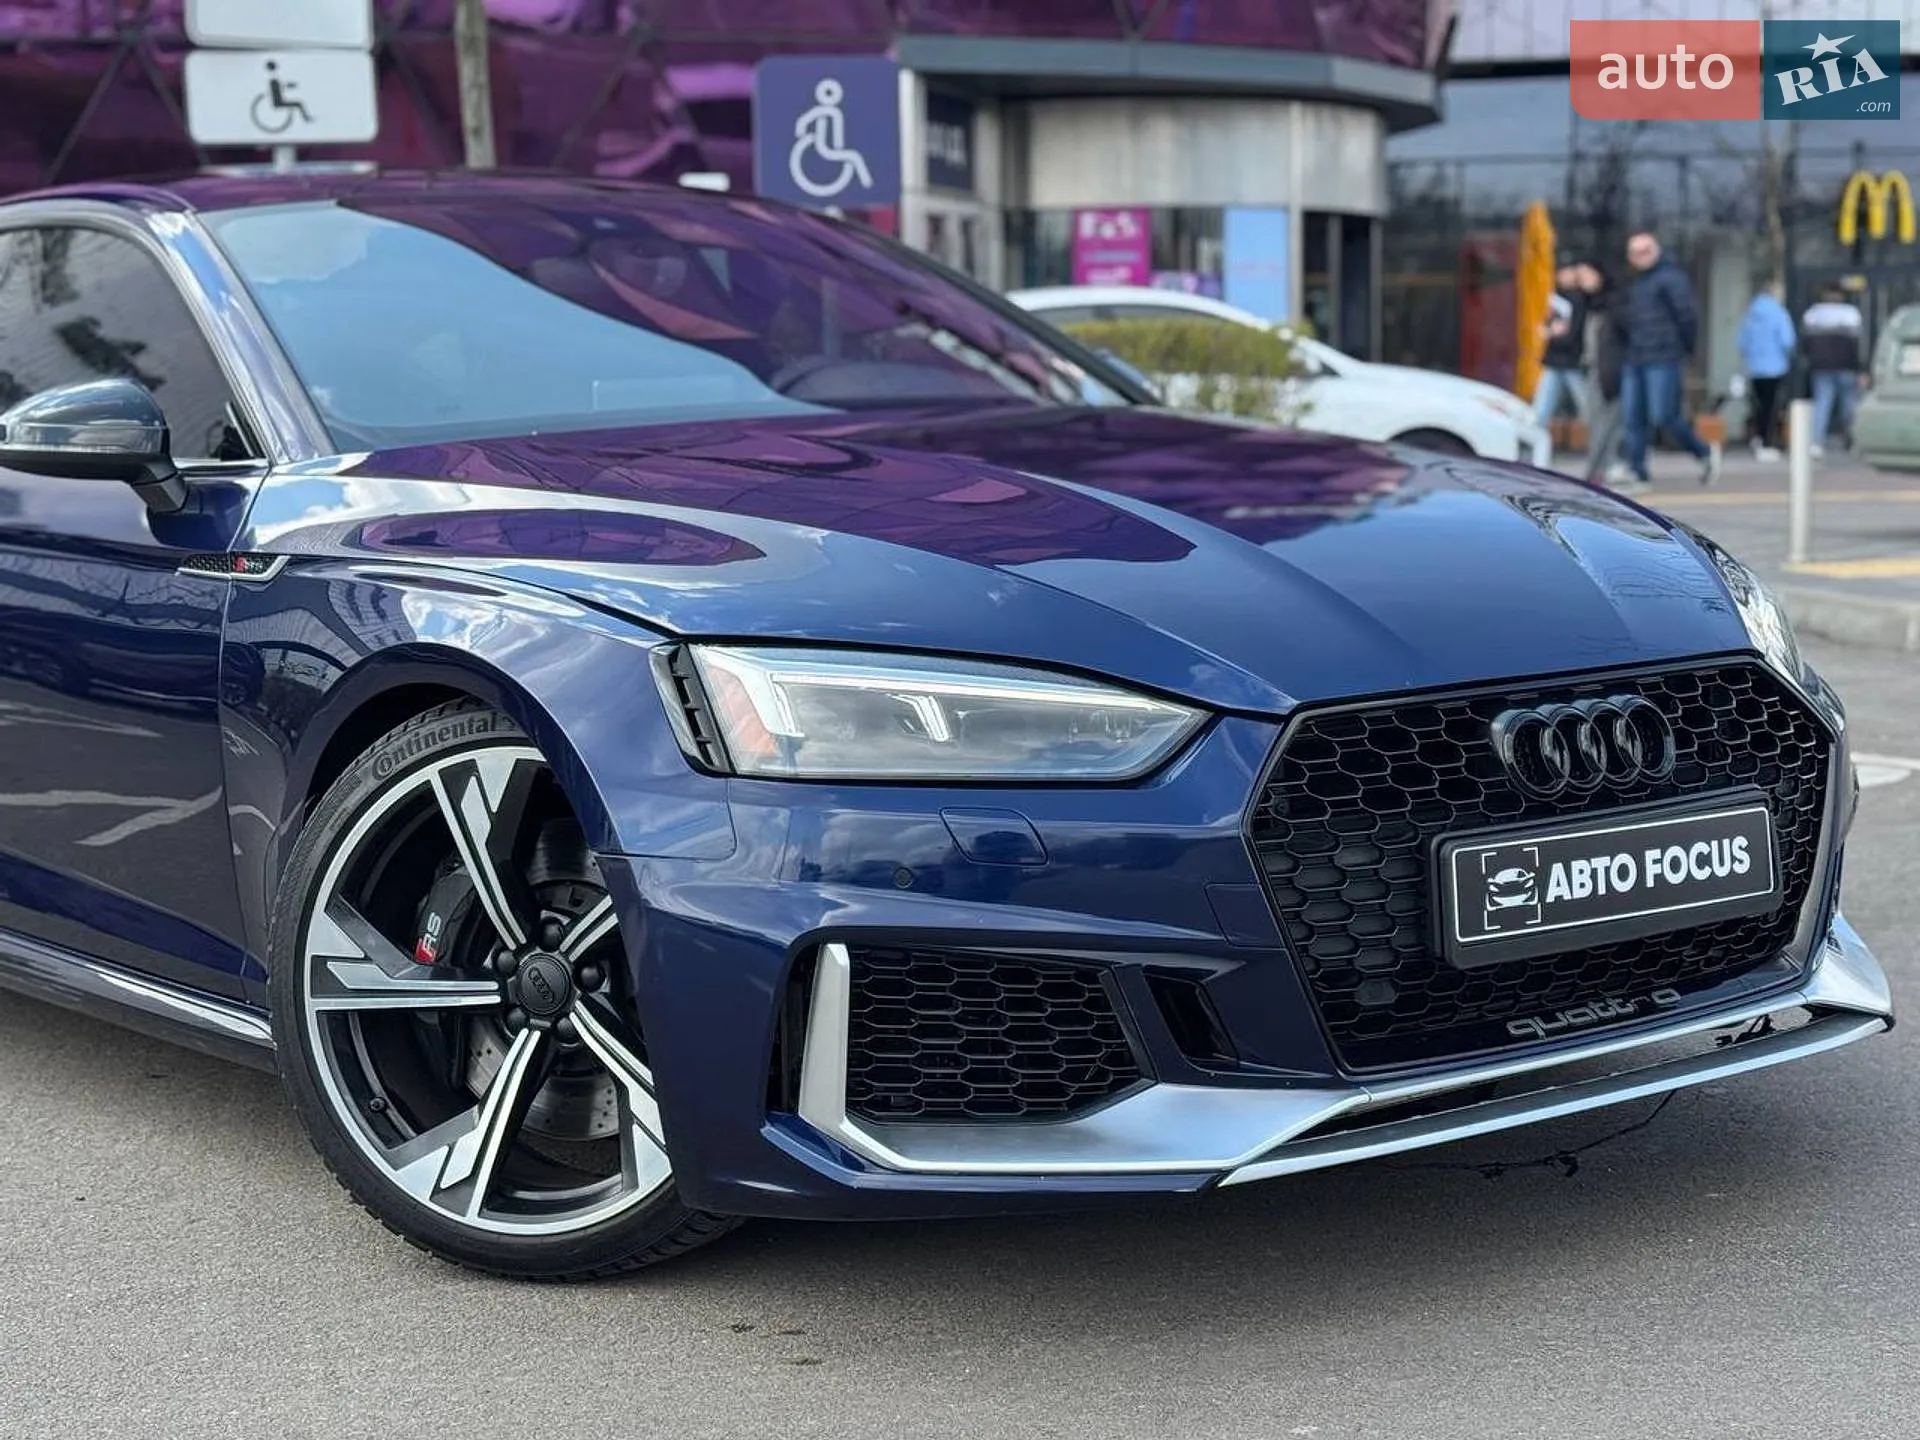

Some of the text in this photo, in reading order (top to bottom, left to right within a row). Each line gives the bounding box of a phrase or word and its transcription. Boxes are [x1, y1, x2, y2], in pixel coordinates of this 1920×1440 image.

[371, 710, 499, 782] Continental
[1644, 835, 1751, 888] FOCUS
[422, 911, 442, 959] RS
[1506, 987, 1682, 1041] quattro
